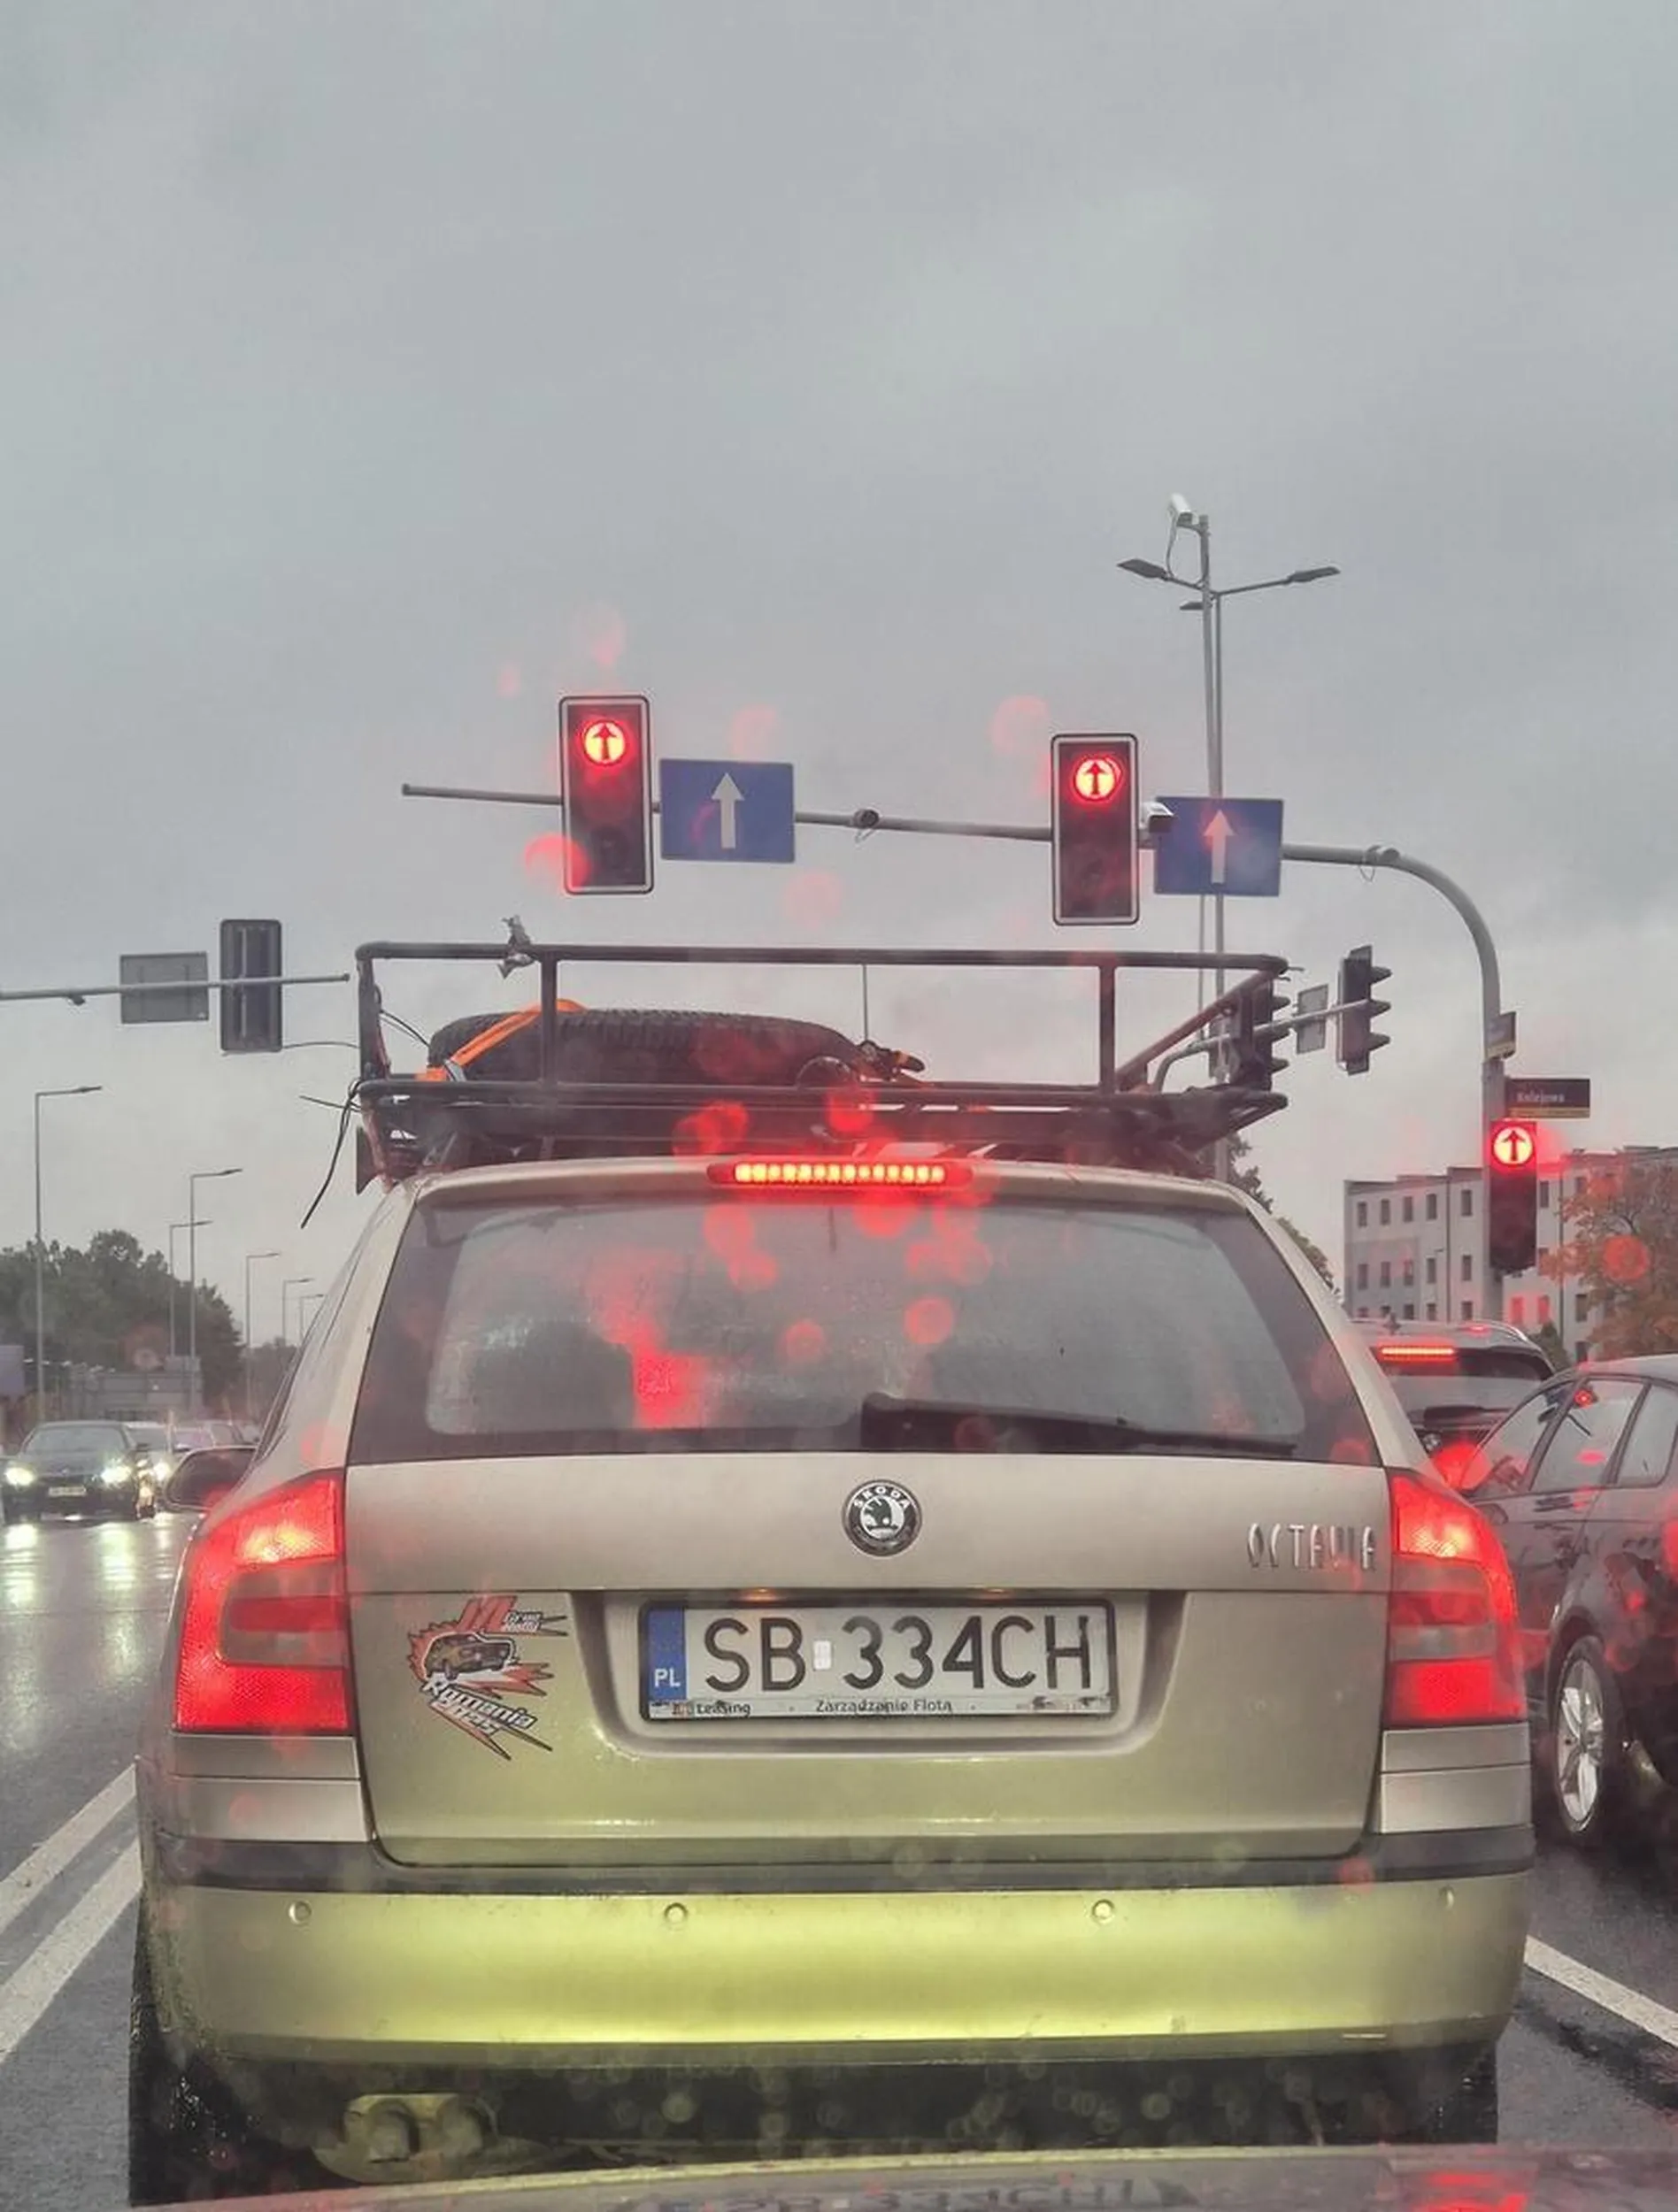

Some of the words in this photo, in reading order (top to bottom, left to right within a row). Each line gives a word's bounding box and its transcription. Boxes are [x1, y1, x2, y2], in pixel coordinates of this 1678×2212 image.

[655, 1668, 681, 1687] PL
[704, 1617, 806, 1693] SB
[842, 1615, 1090, 1691] 334CH
